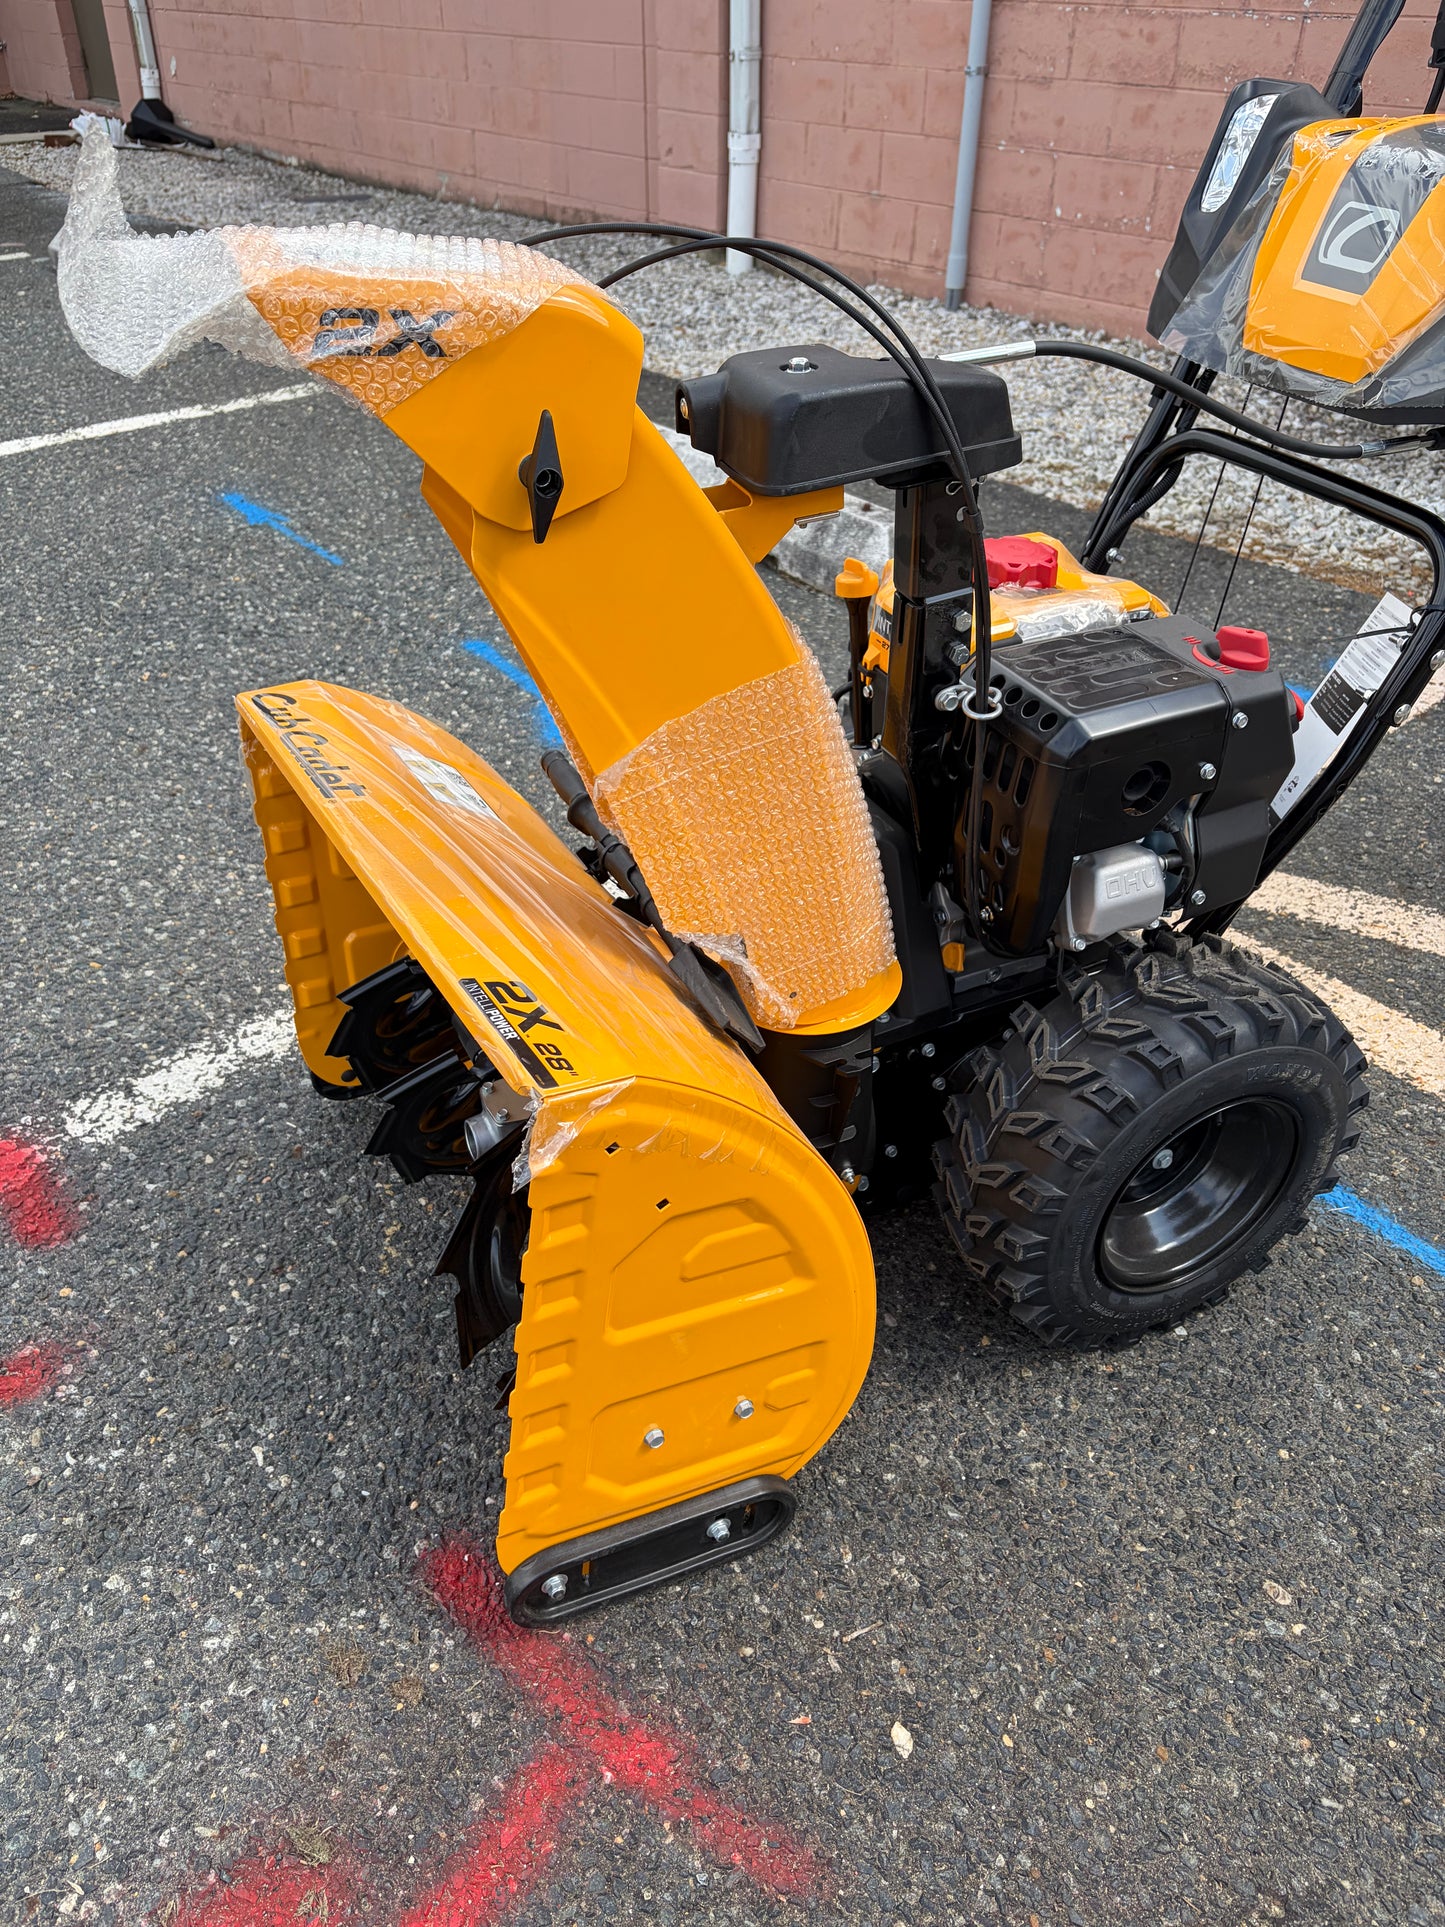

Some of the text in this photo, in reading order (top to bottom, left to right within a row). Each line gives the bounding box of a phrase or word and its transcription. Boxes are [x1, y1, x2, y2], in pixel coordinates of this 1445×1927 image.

[251, 692, 367, 799] Cub Cadet
[483, 980, 580, 1077] 2X 28"
